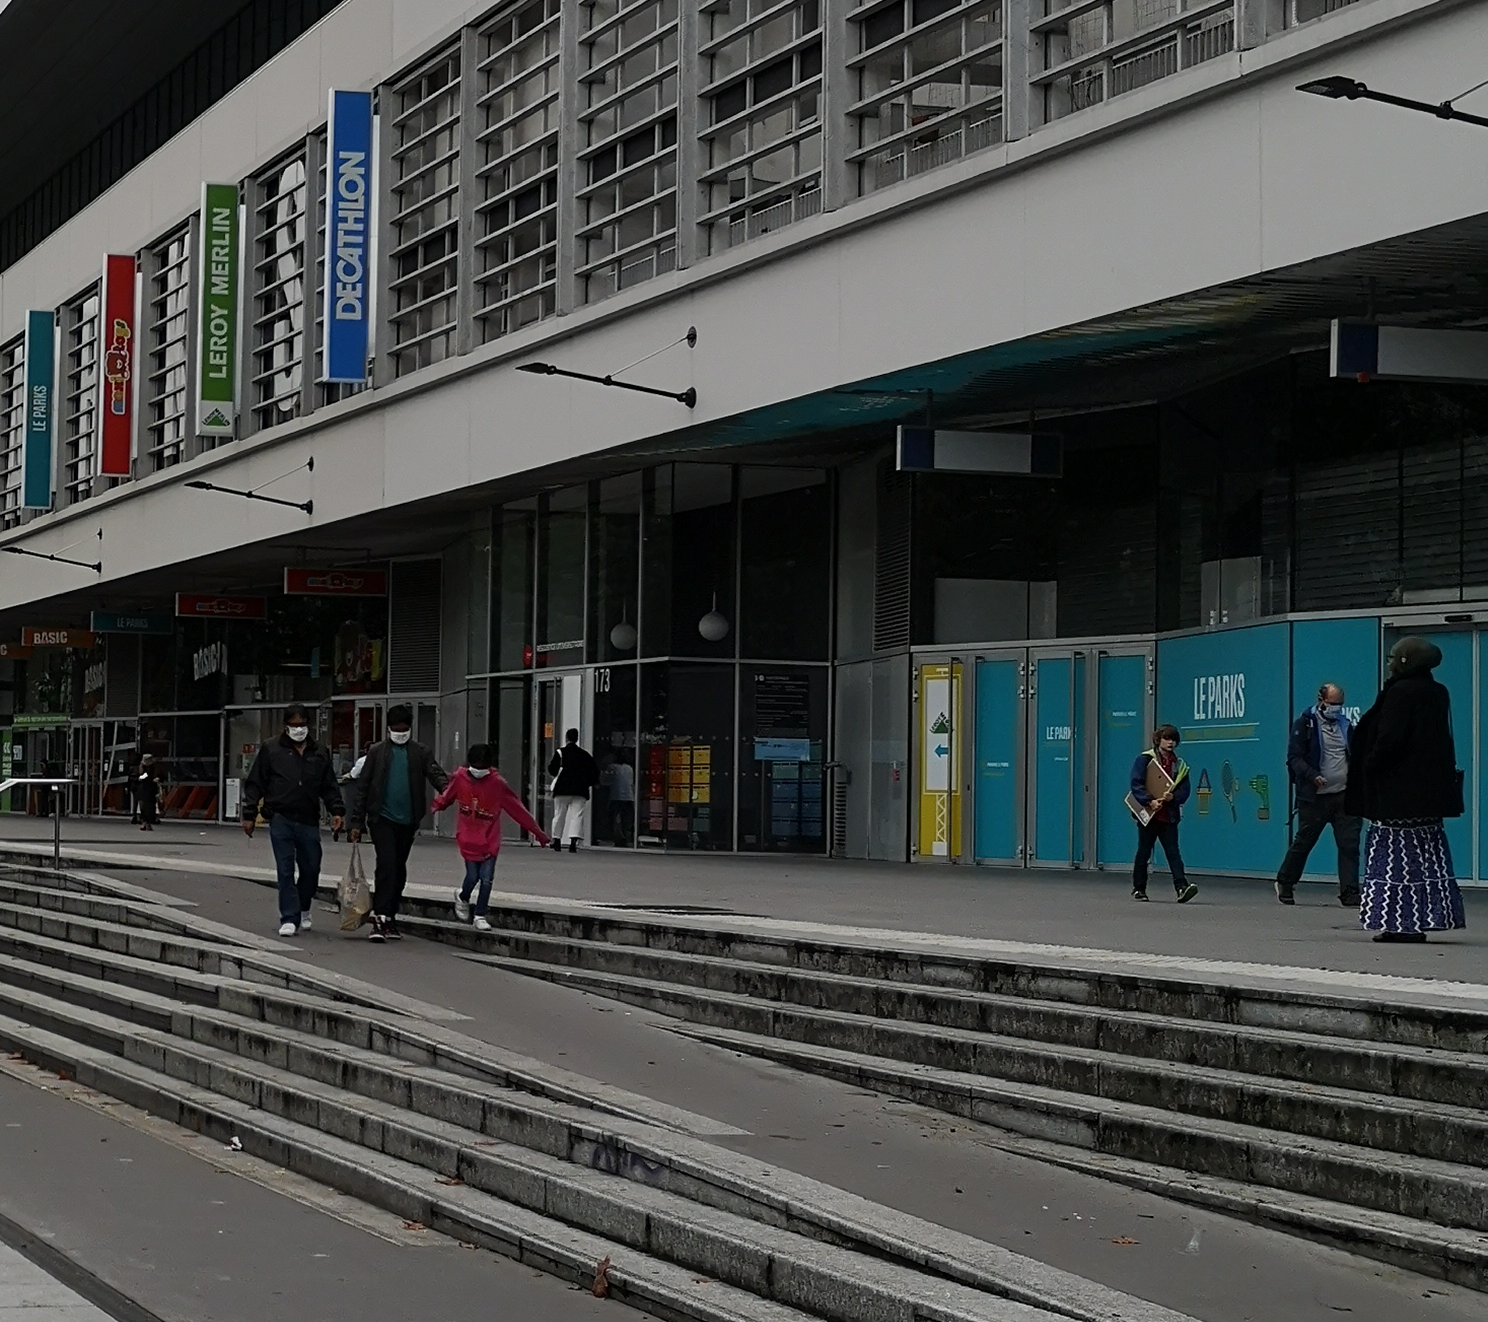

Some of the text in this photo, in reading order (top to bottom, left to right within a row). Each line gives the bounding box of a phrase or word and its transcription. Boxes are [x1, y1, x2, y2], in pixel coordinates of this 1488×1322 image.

[335, 150, 366, 320] DECATHLON
[209, 207, 231, 379] LEROY MERLIN
[32, 384, 48, 432] LE PARKS
[33, 631, 68, 645] BASIC
[594, 668, 611, 693] 173
[1194, 673, 1245, 720] LE PARKS
[1046, 726, 1054, 740] LE
